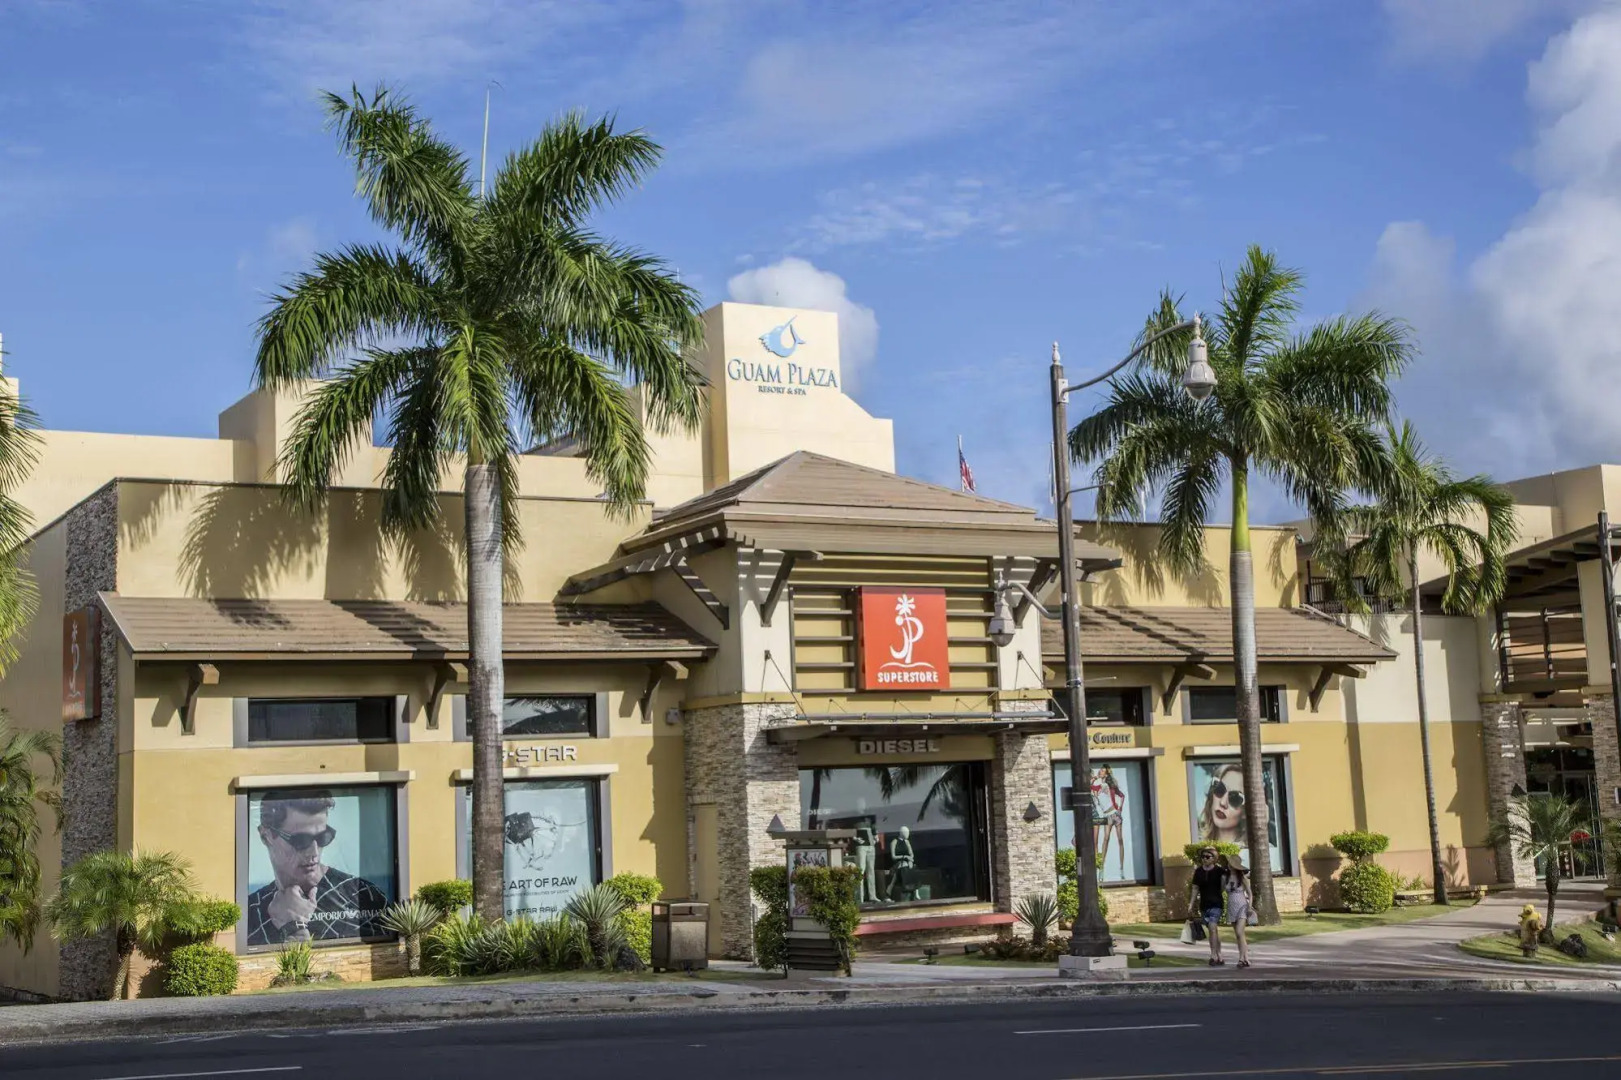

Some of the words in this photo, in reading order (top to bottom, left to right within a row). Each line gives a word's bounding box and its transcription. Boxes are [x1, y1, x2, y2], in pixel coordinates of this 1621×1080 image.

[727, 358, 782, 384] GUAM
[788, 362, 838, 388] PLAZA
[758, 385, 785, 395] RESORT
[877, 671, 939, 683] SUPERSTORE
[859, 739, 940, 754] DIESEL
[509, 879, 532, 890] ART
[534, 878, 549, 888] OF
[552, 876, 578, 887] RAW
[308, 910, 346, 922] EMPORIO
